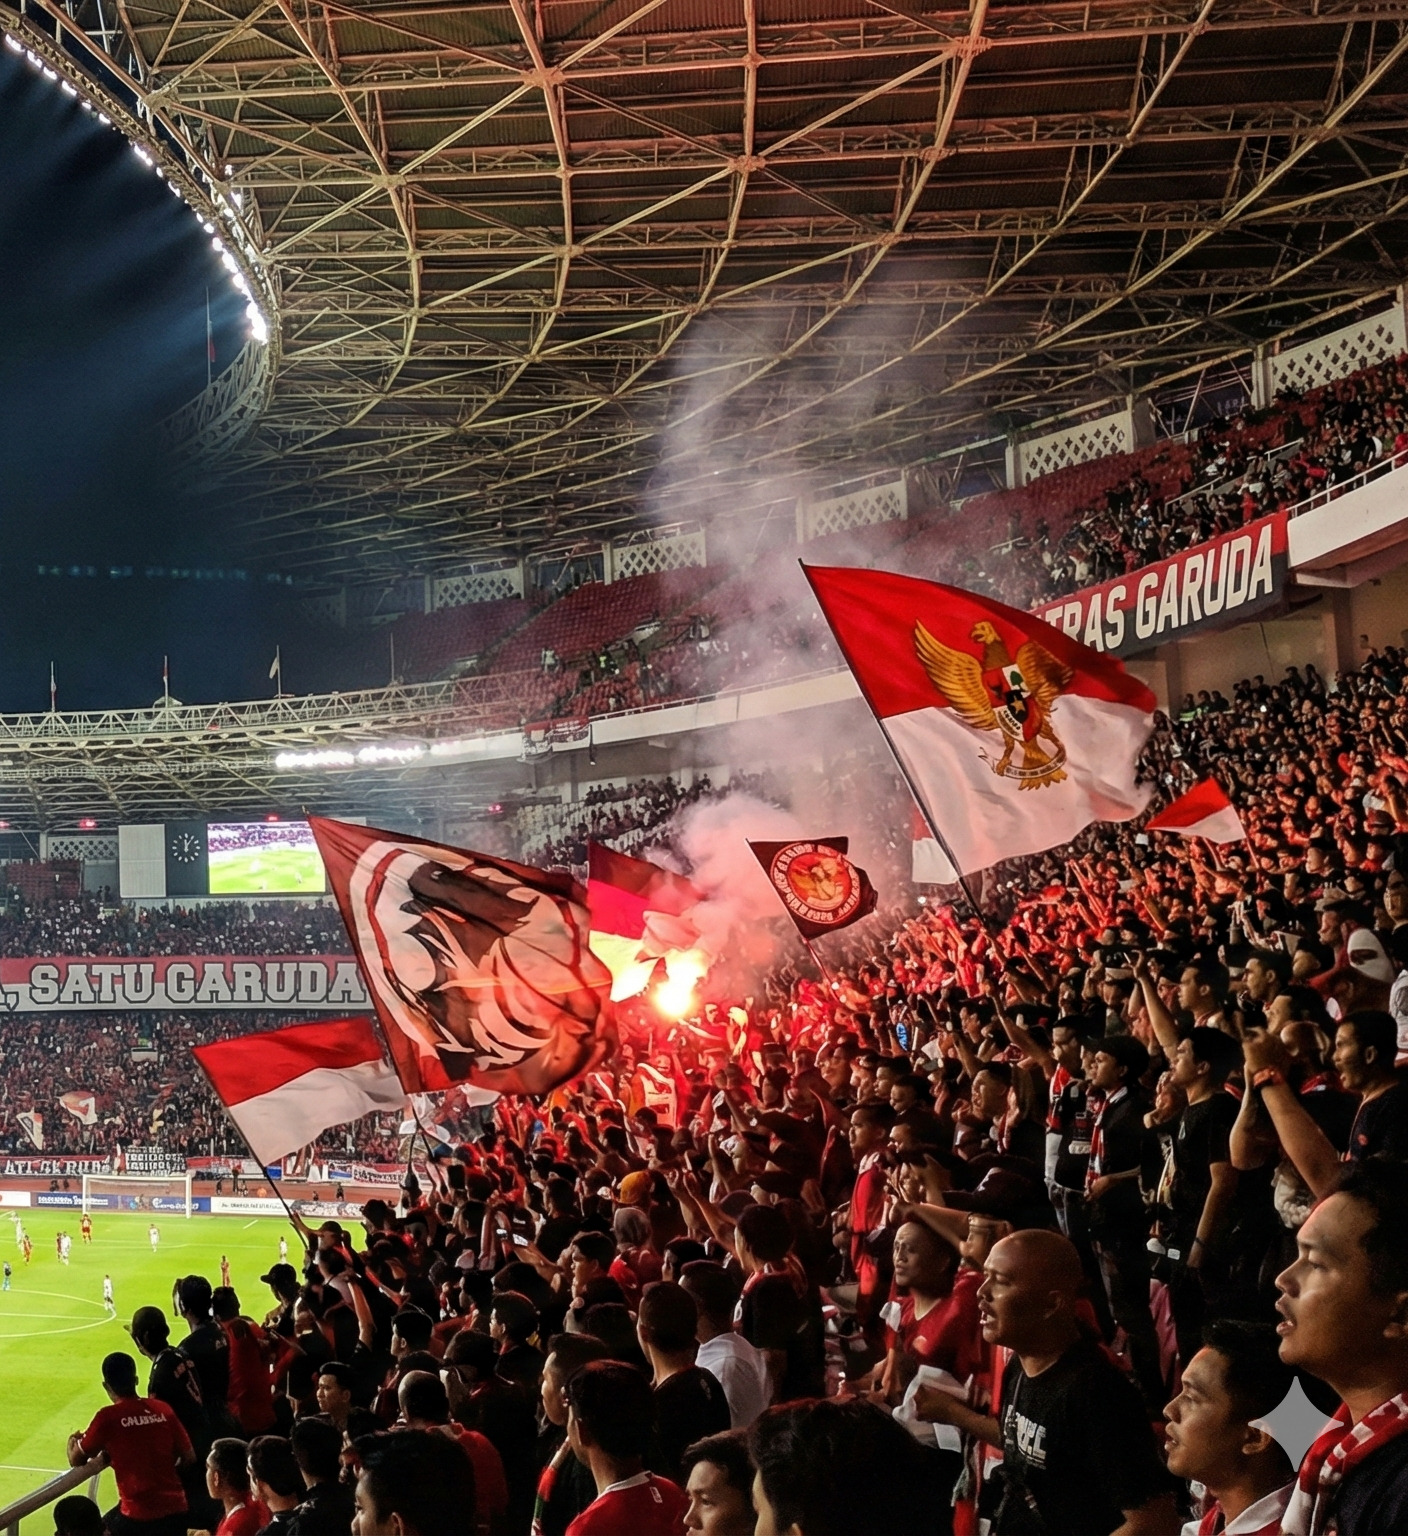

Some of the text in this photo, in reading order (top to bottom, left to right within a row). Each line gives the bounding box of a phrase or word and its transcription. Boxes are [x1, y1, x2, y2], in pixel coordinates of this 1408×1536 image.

[1036, 523, 1274, 653] TRAS GARUDA
[29, 961, 156, 1004] SATU
[164, 961, 367, 1004] GARUDA
